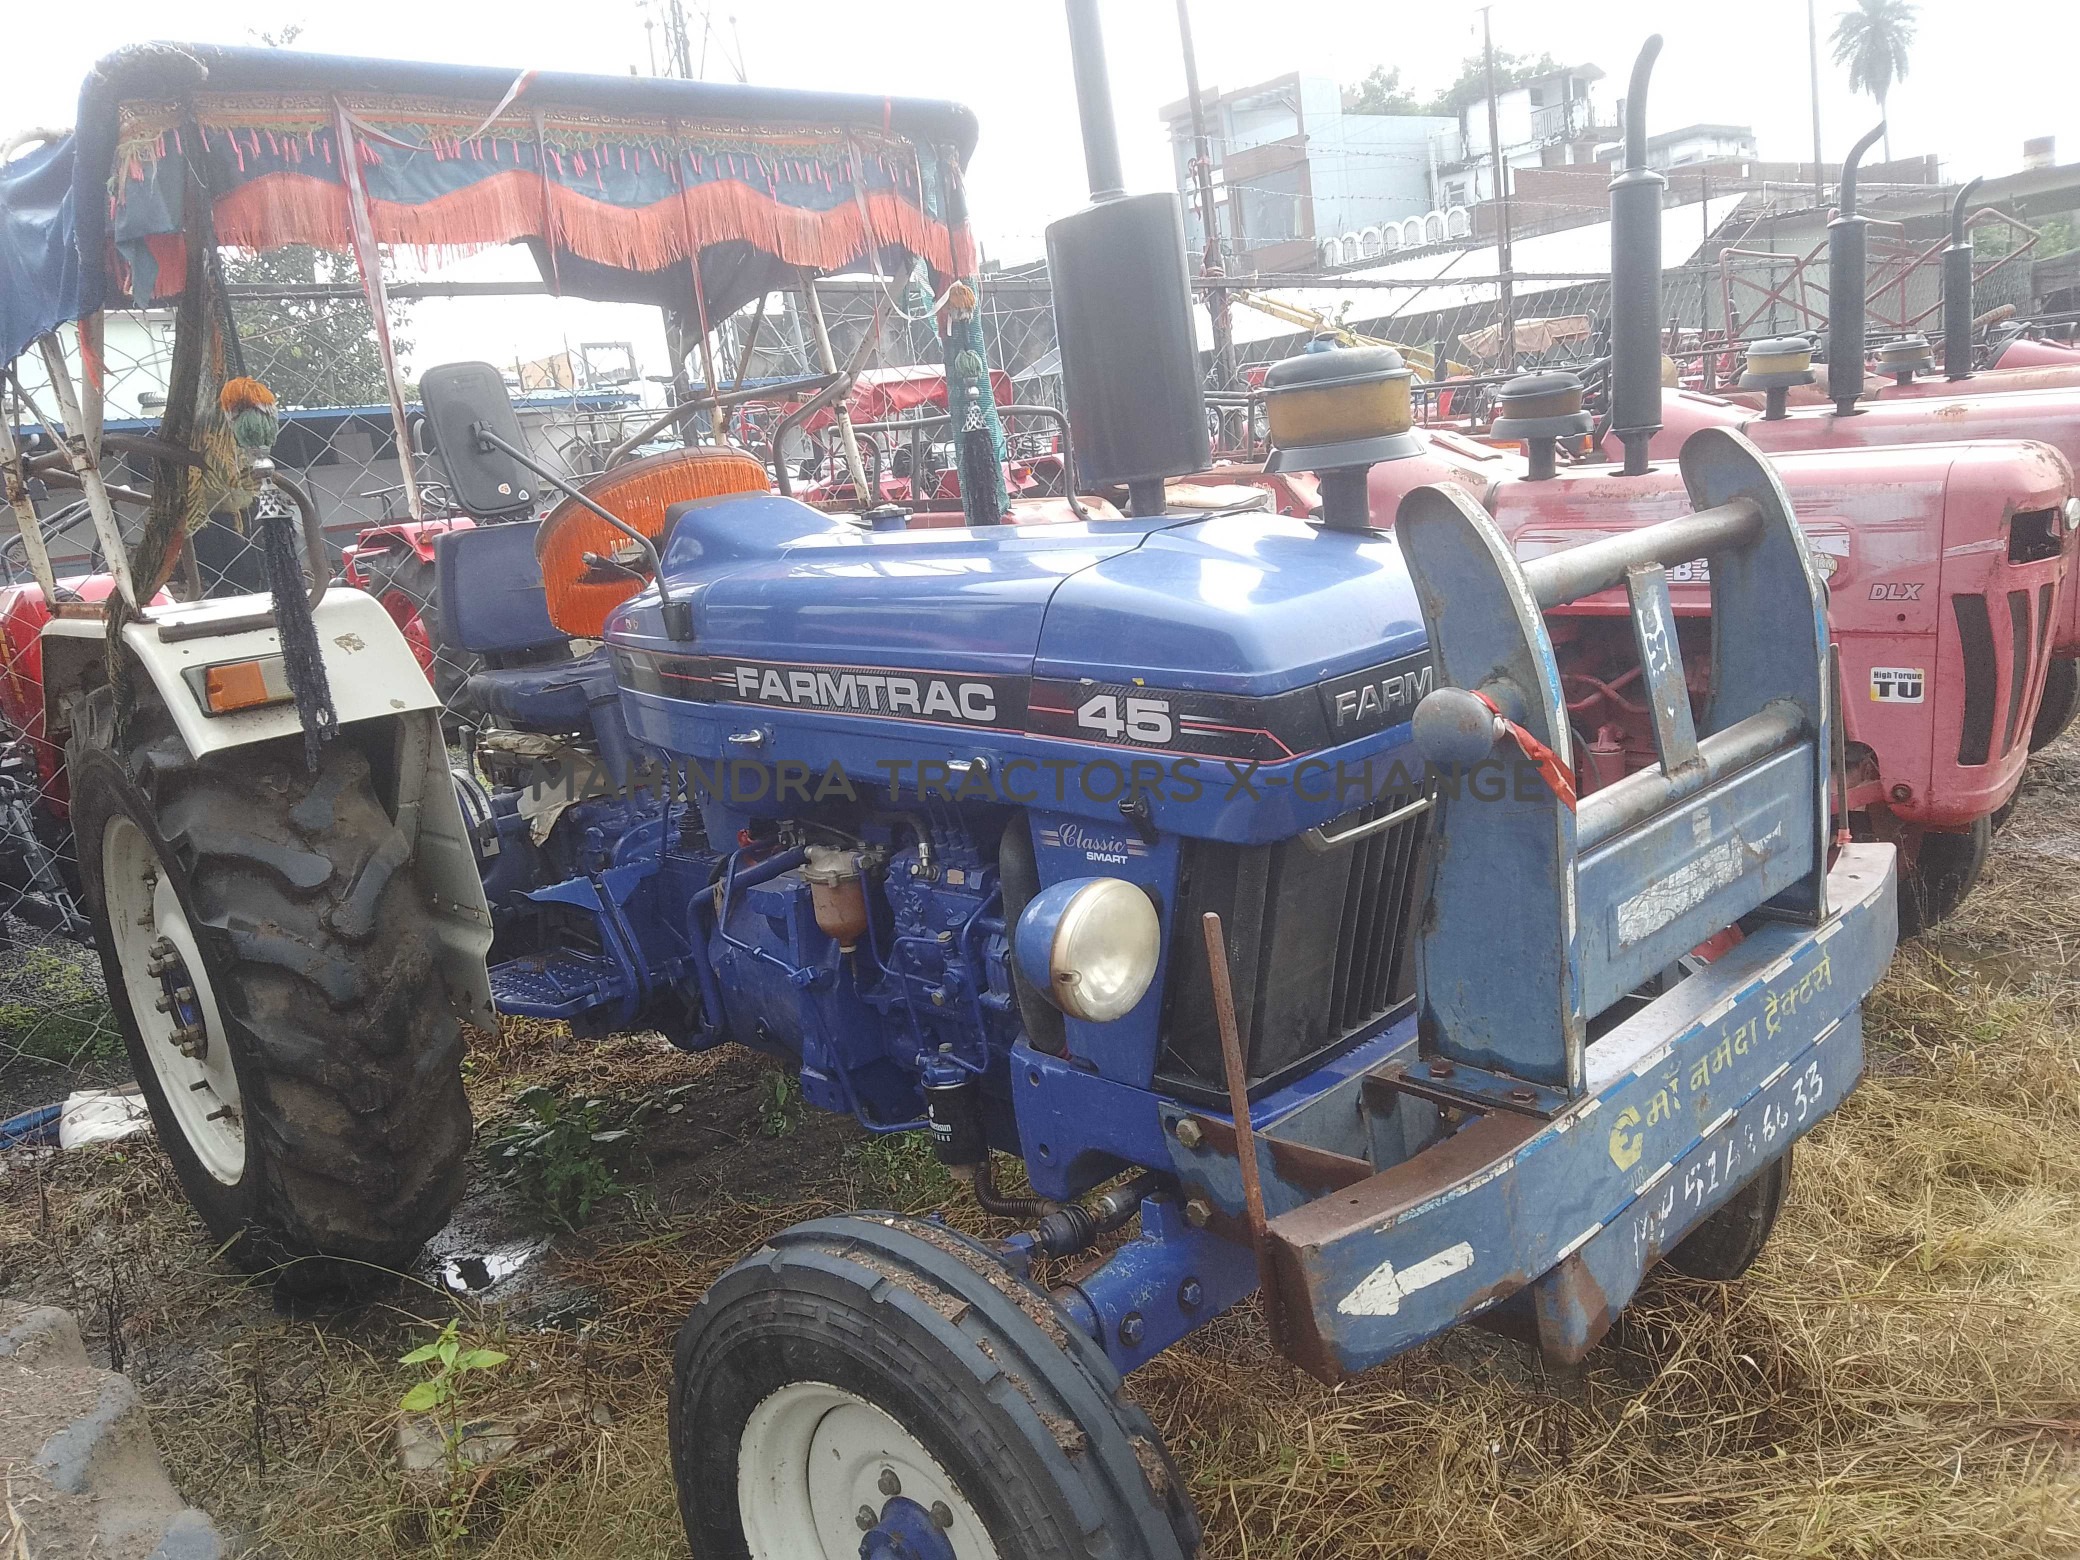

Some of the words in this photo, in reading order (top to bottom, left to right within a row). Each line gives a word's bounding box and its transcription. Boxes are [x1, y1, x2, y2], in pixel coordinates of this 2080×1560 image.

[1868, 583, 1924, 600] DLX
[1873, 671, 1892, 680] High
[1894, 671, 1922, 680] Torque
[1873, 681, 1922, 698] TU
[736, 666, 996, 722] FARMTRAC
[1077, 695, 1172, 743] 45
[1059, 823, 1125, 852] Classic
[1086, 851, 1128, 864] SMART
